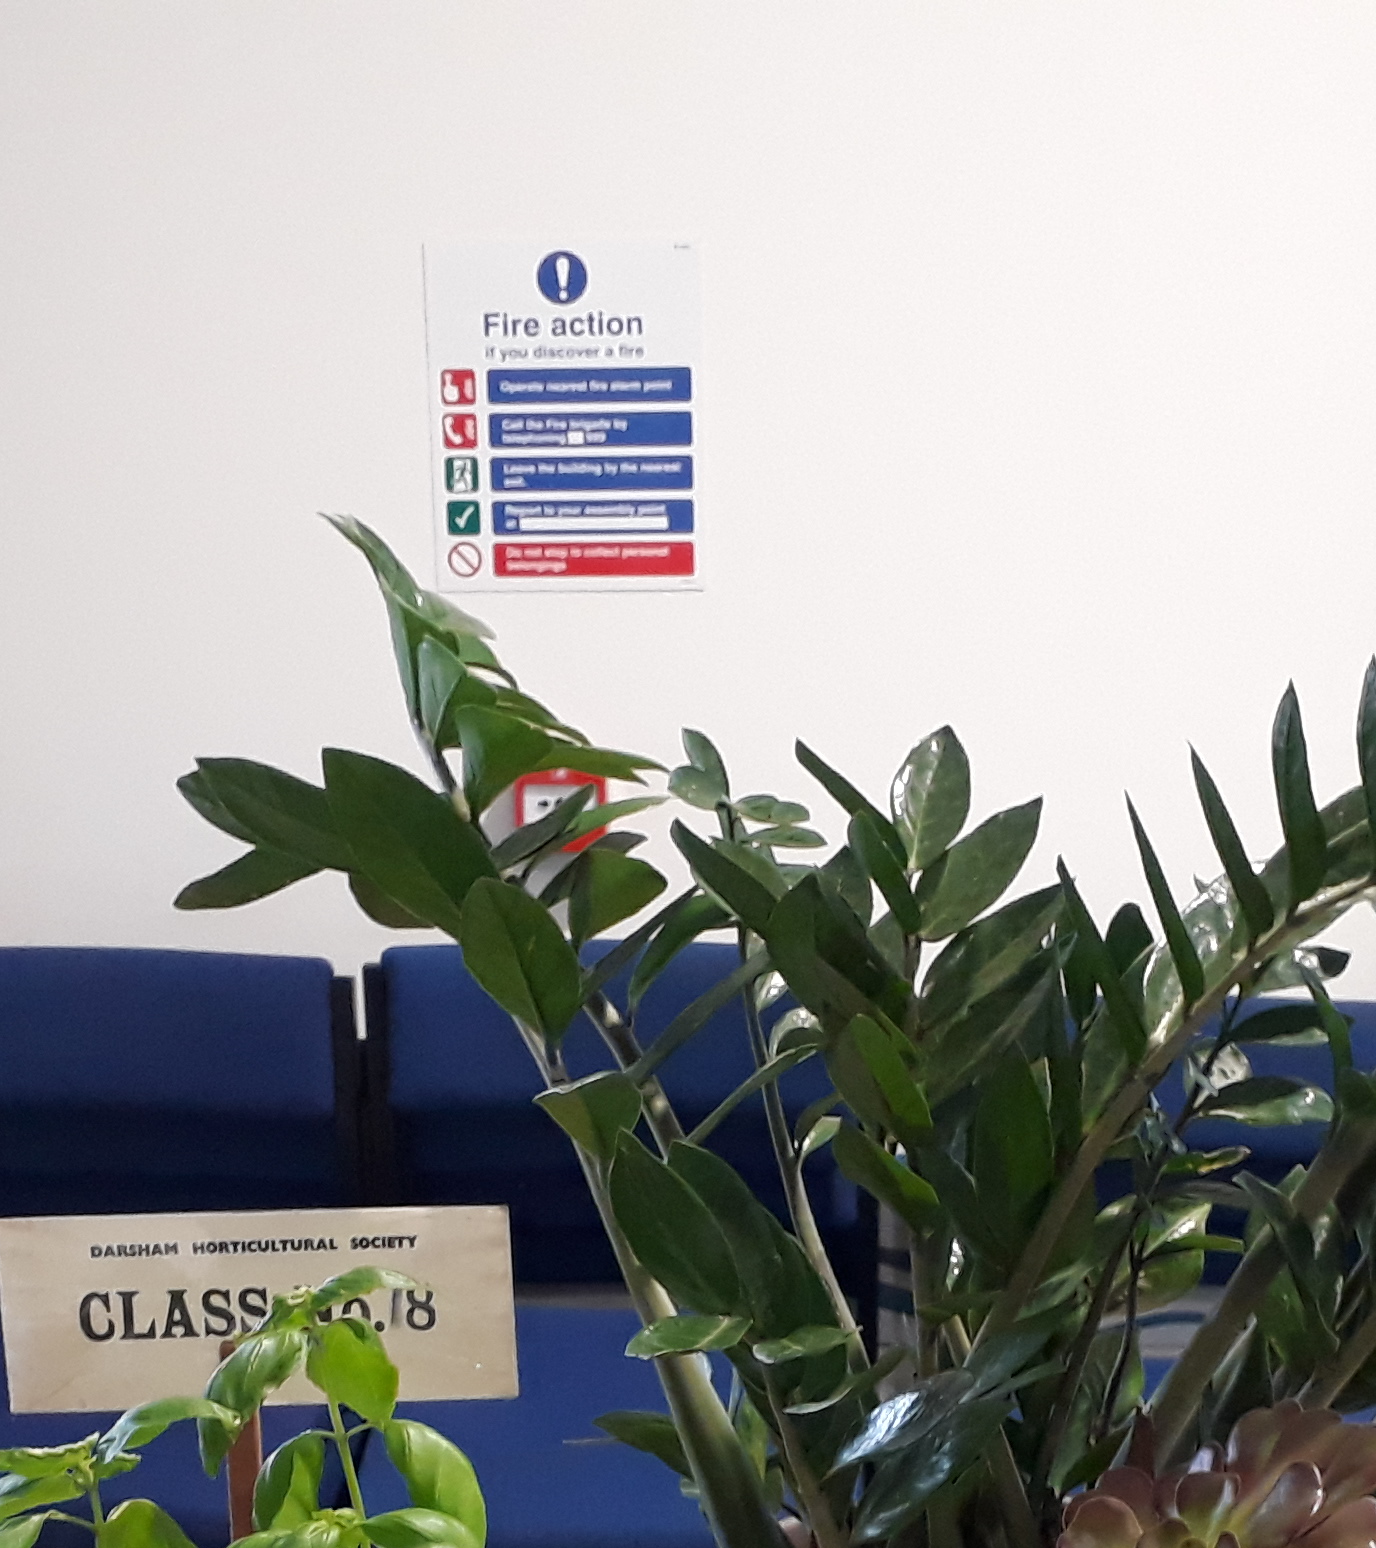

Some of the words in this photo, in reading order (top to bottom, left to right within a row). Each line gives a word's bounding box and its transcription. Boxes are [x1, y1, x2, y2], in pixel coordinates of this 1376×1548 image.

[483, 312, 539, 337] Fire
[551, 311, 643, 337] action
[498, 348, 528, 363] you
[534, 345, 599, 359] discover
[606, 348, 613, 358] a
[618, 345, 644, 359] fire
[90, 1243, 178, 1258] DARSHAM
[192, 1237, 337, 1255] HORTICULTURAL
[351, 1235, 417, 1250] SOCIETY
[79, 1287, 267, 1342] CLASS
